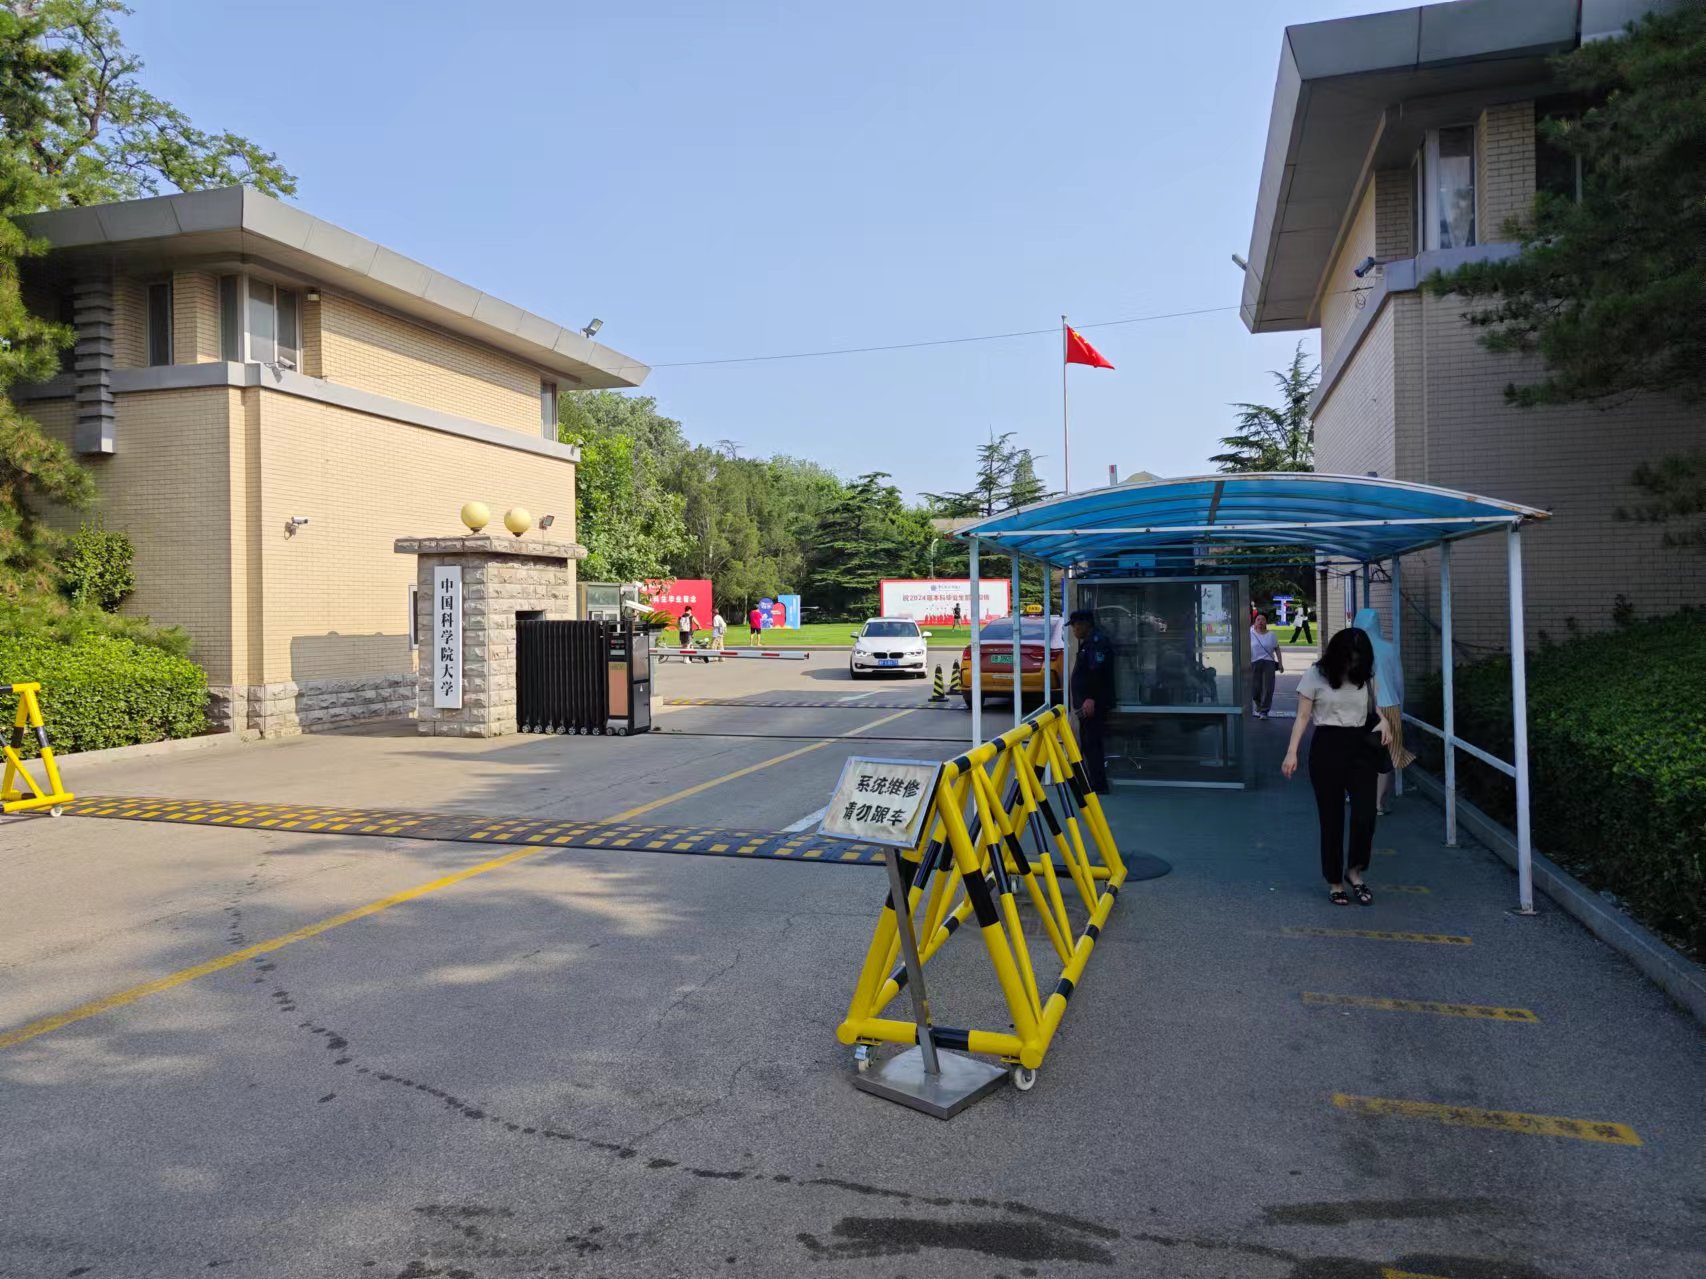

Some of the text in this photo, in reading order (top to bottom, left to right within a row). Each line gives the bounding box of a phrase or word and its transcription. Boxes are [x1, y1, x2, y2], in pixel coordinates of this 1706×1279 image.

[441, 578, 454, 697] 中国科学院大学
[856, 775, 920, 797] 系统维修
[843, 801, 906, 826] 请勿跟车
